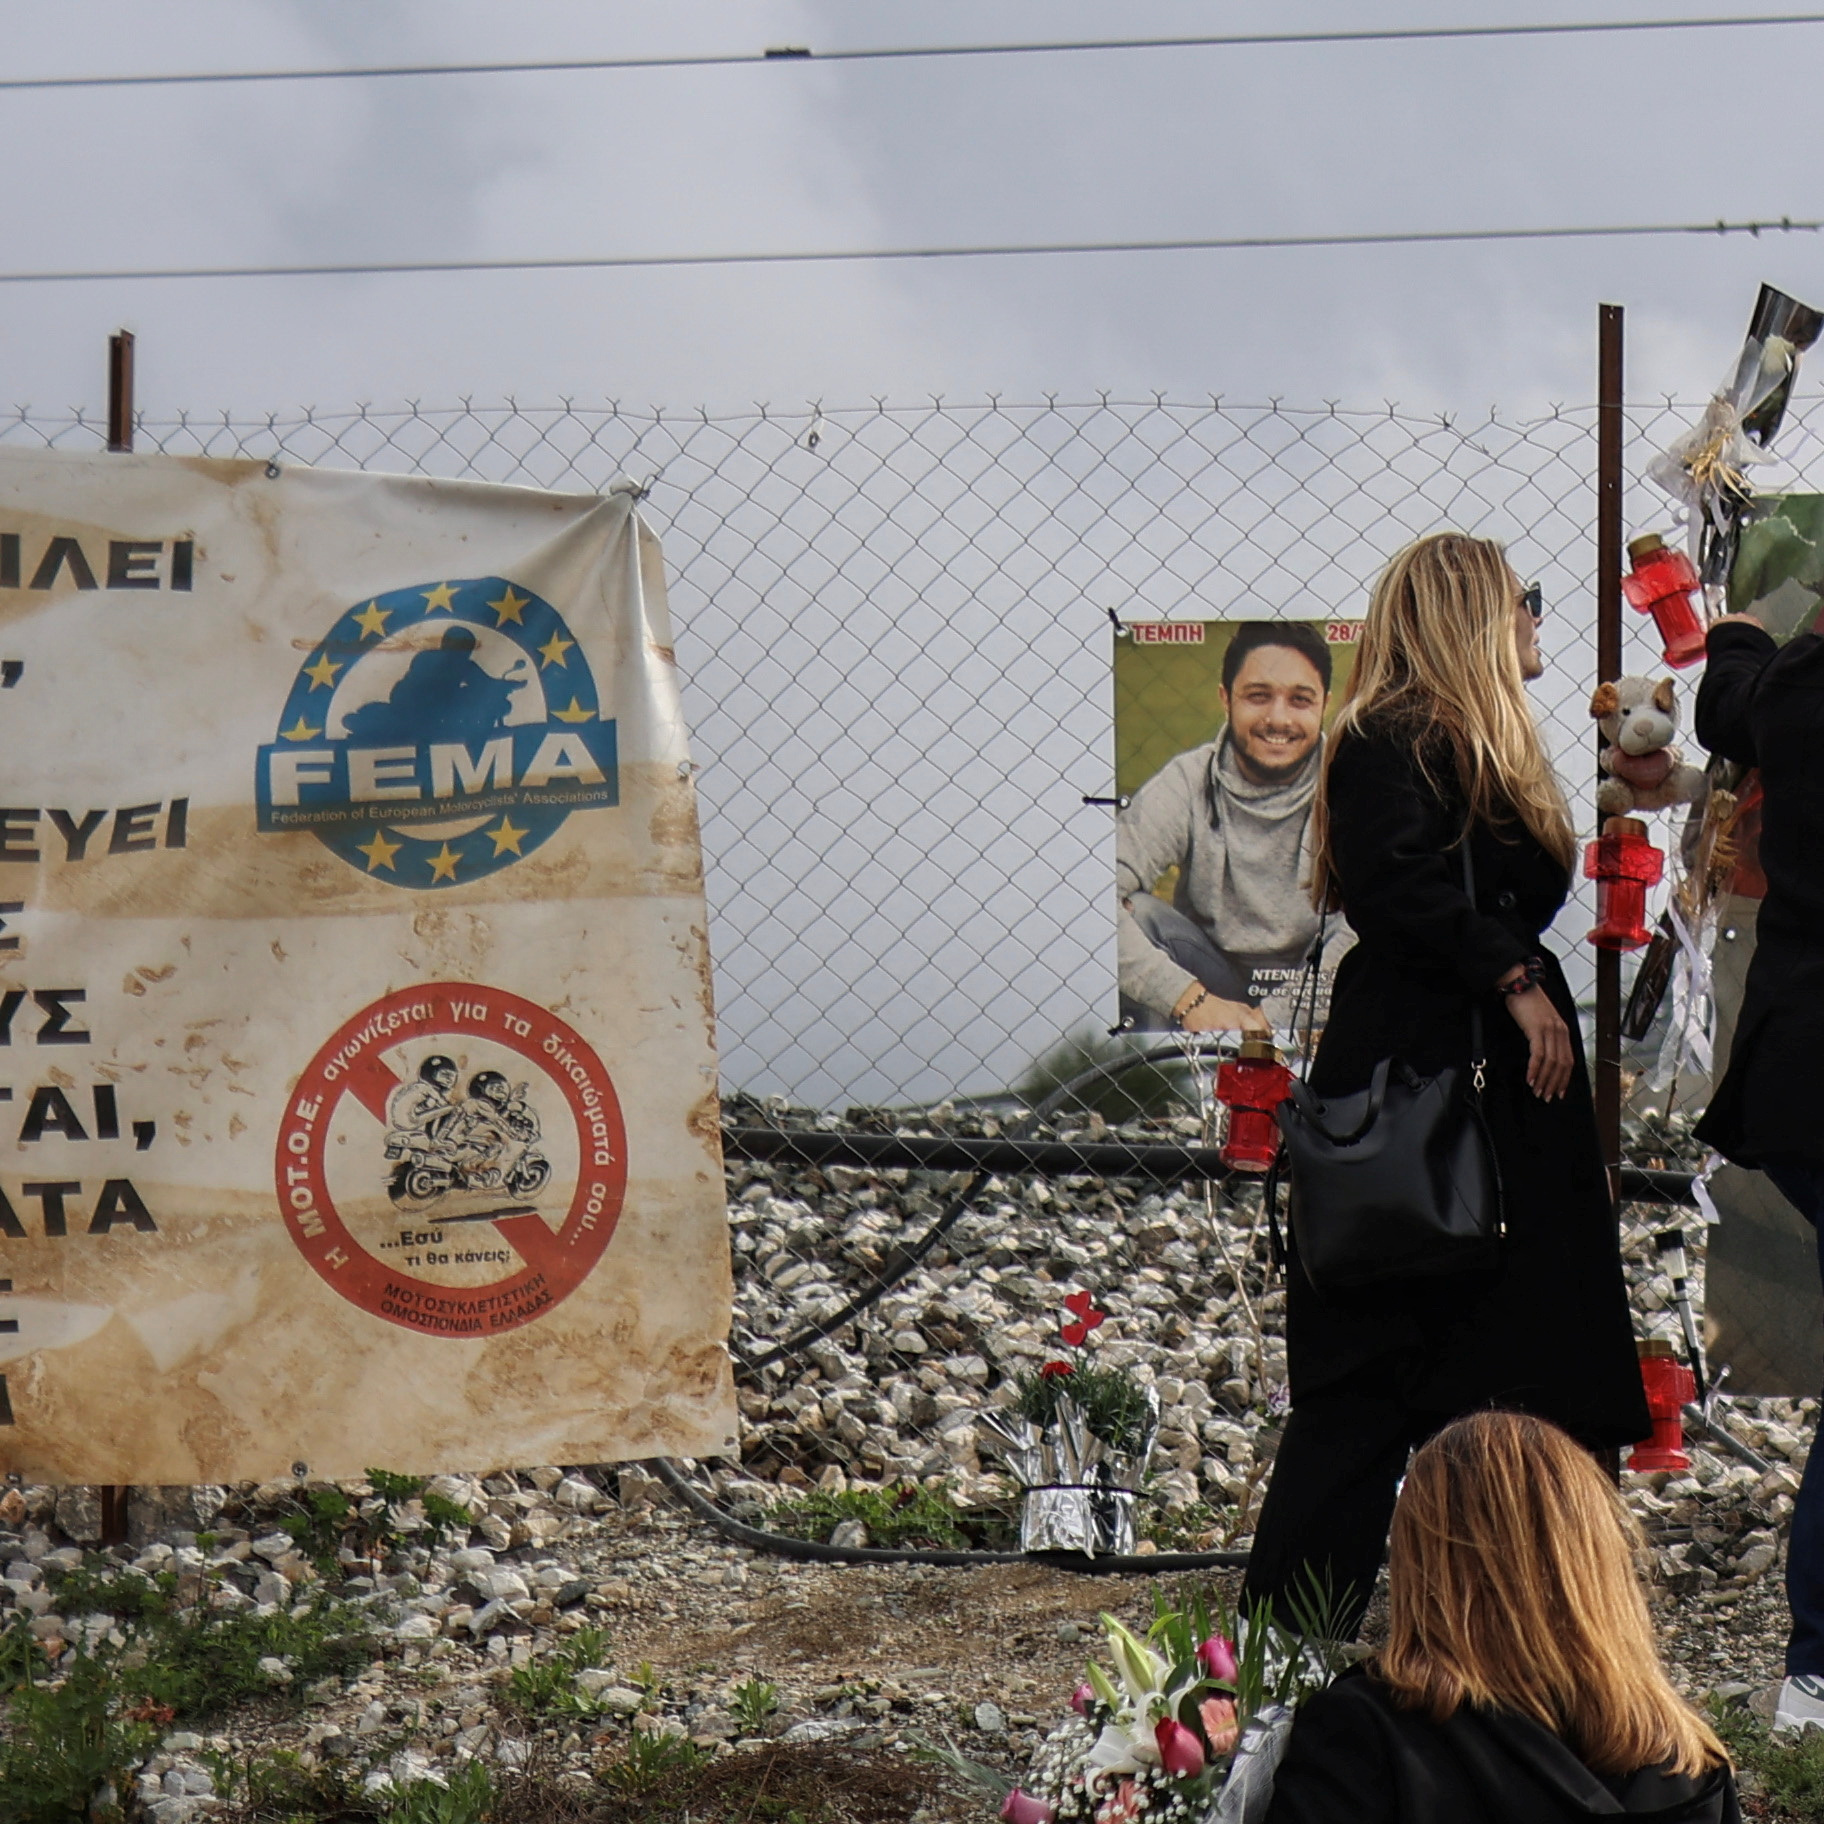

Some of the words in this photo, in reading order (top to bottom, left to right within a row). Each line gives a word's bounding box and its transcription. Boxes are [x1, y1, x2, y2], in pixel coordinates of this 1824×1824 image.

[1132, 624, 1204, 642] ΤΕΜΠΗ
[269, 732, 607, 806] FEMA
[271, 809, 347, 825] Federation
[351, 807, 366, 821] of
[369, 803, 437, 821] European
[523, 789, 609, 806] Associations
[449, 1000, 488, 1024] για
[503, 1011, 533, 1037] τα
[324, 1001, 434, 1082] αγωνίζεται
[0, 1085, 156, 1151] ΑΙ,
[542, 1032, 616, 1167] δικαιώματά
[324, 1247, 350, 1271] Η
[405, 1255, 421, 1267] τι
[426, 1252, 449, 1266] θα
[380, 1300, 483, 1332] ΟΜΟΣΠΟΝΔΙΑ
[490, 1289, 553, 1327] ΕΛΛΑΔΑΣ
[383, 1273, 546, 1315] ΜΟΤΟΣΥΚΛΕΤΙΣΤΙΚΗ
